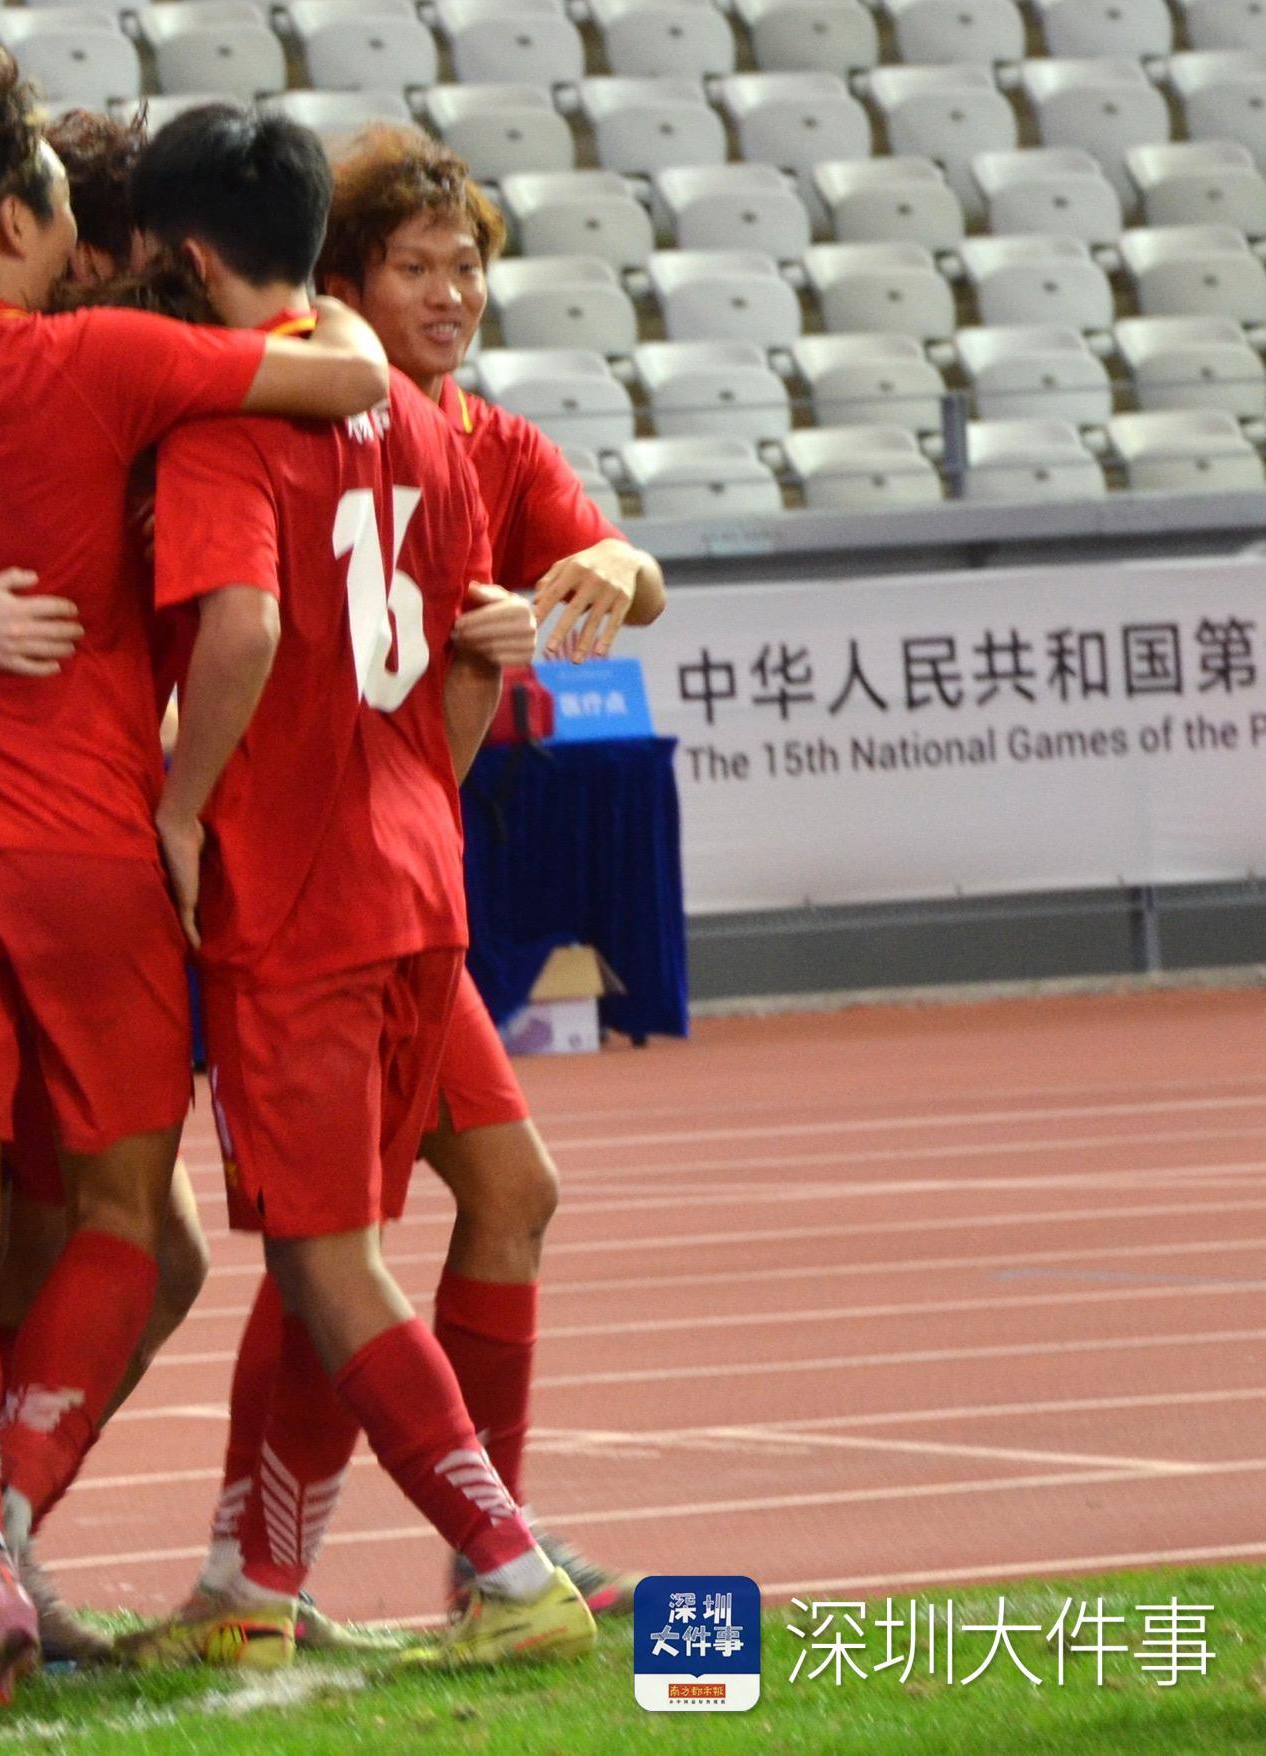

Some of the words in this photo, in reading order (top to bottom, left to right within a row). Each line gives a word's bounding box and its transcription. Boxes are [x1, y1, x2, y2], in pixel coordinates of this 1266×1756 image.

[332, 484, 430, 713] 16
[678, 616, 1257, 726] 中华人民共和国第
[687, 745, 749, 782] The
[764, 741, 839, 778] 15th
[851, 727, 997, 773] National
[1009, 720, 1128, 764] Games
[1141, 714, 1179, 754] of
[1185, 711, 1239, 750] the
